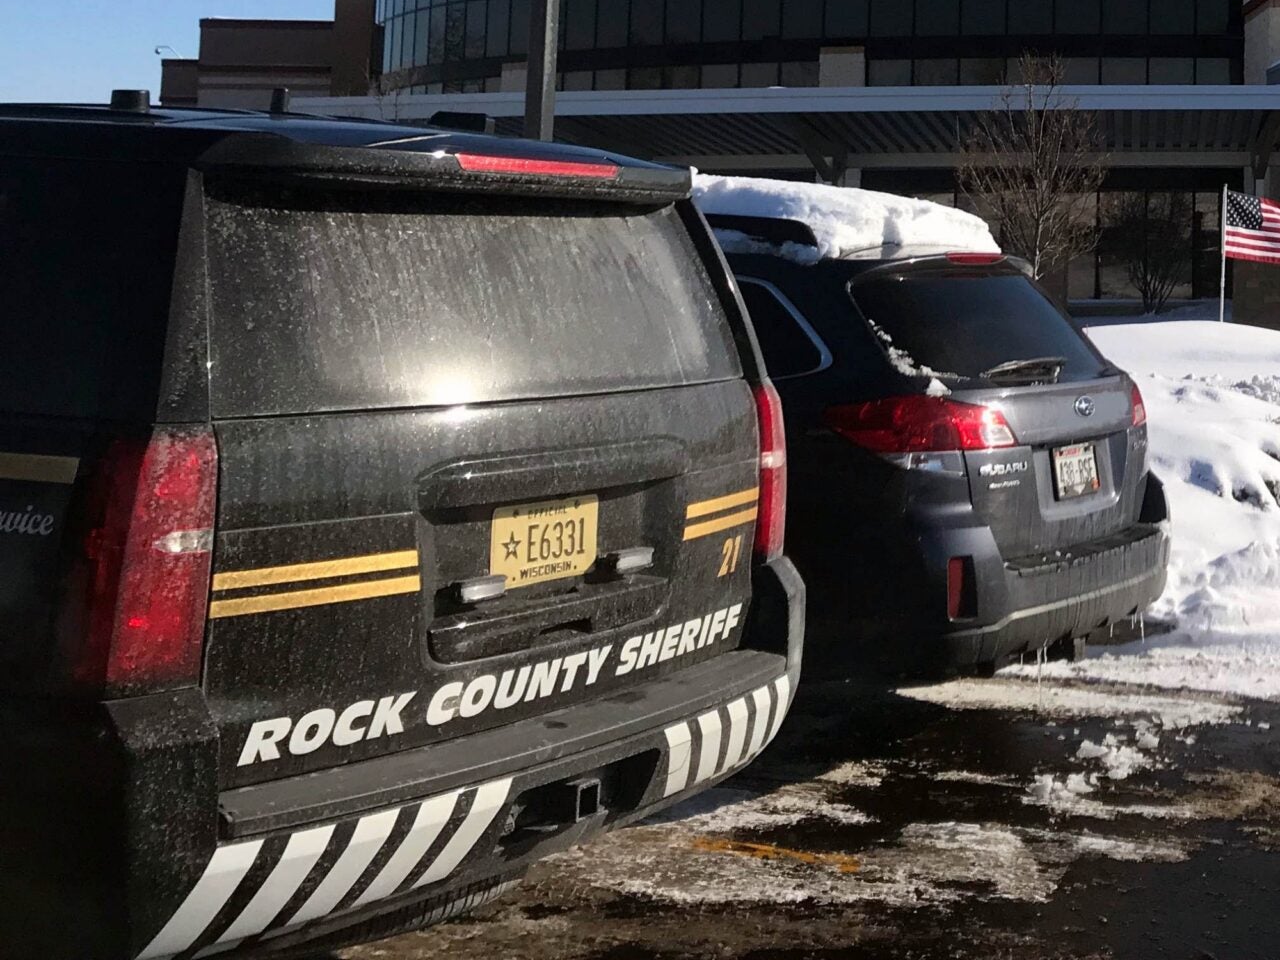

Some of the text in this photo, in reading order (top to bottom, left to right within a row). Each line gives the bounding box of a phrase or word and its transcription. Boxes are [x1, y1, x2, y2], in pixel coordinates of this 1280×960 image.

[527, 505, 568, 520] OFFICIAL
[526, 517, 586, 564] E6331
[717, 535, 743, 578] 21
[519, 561, 572, 580] WISCONSIN
[237, 602, 744, 767] ROCK COUNTY SHERIFF
